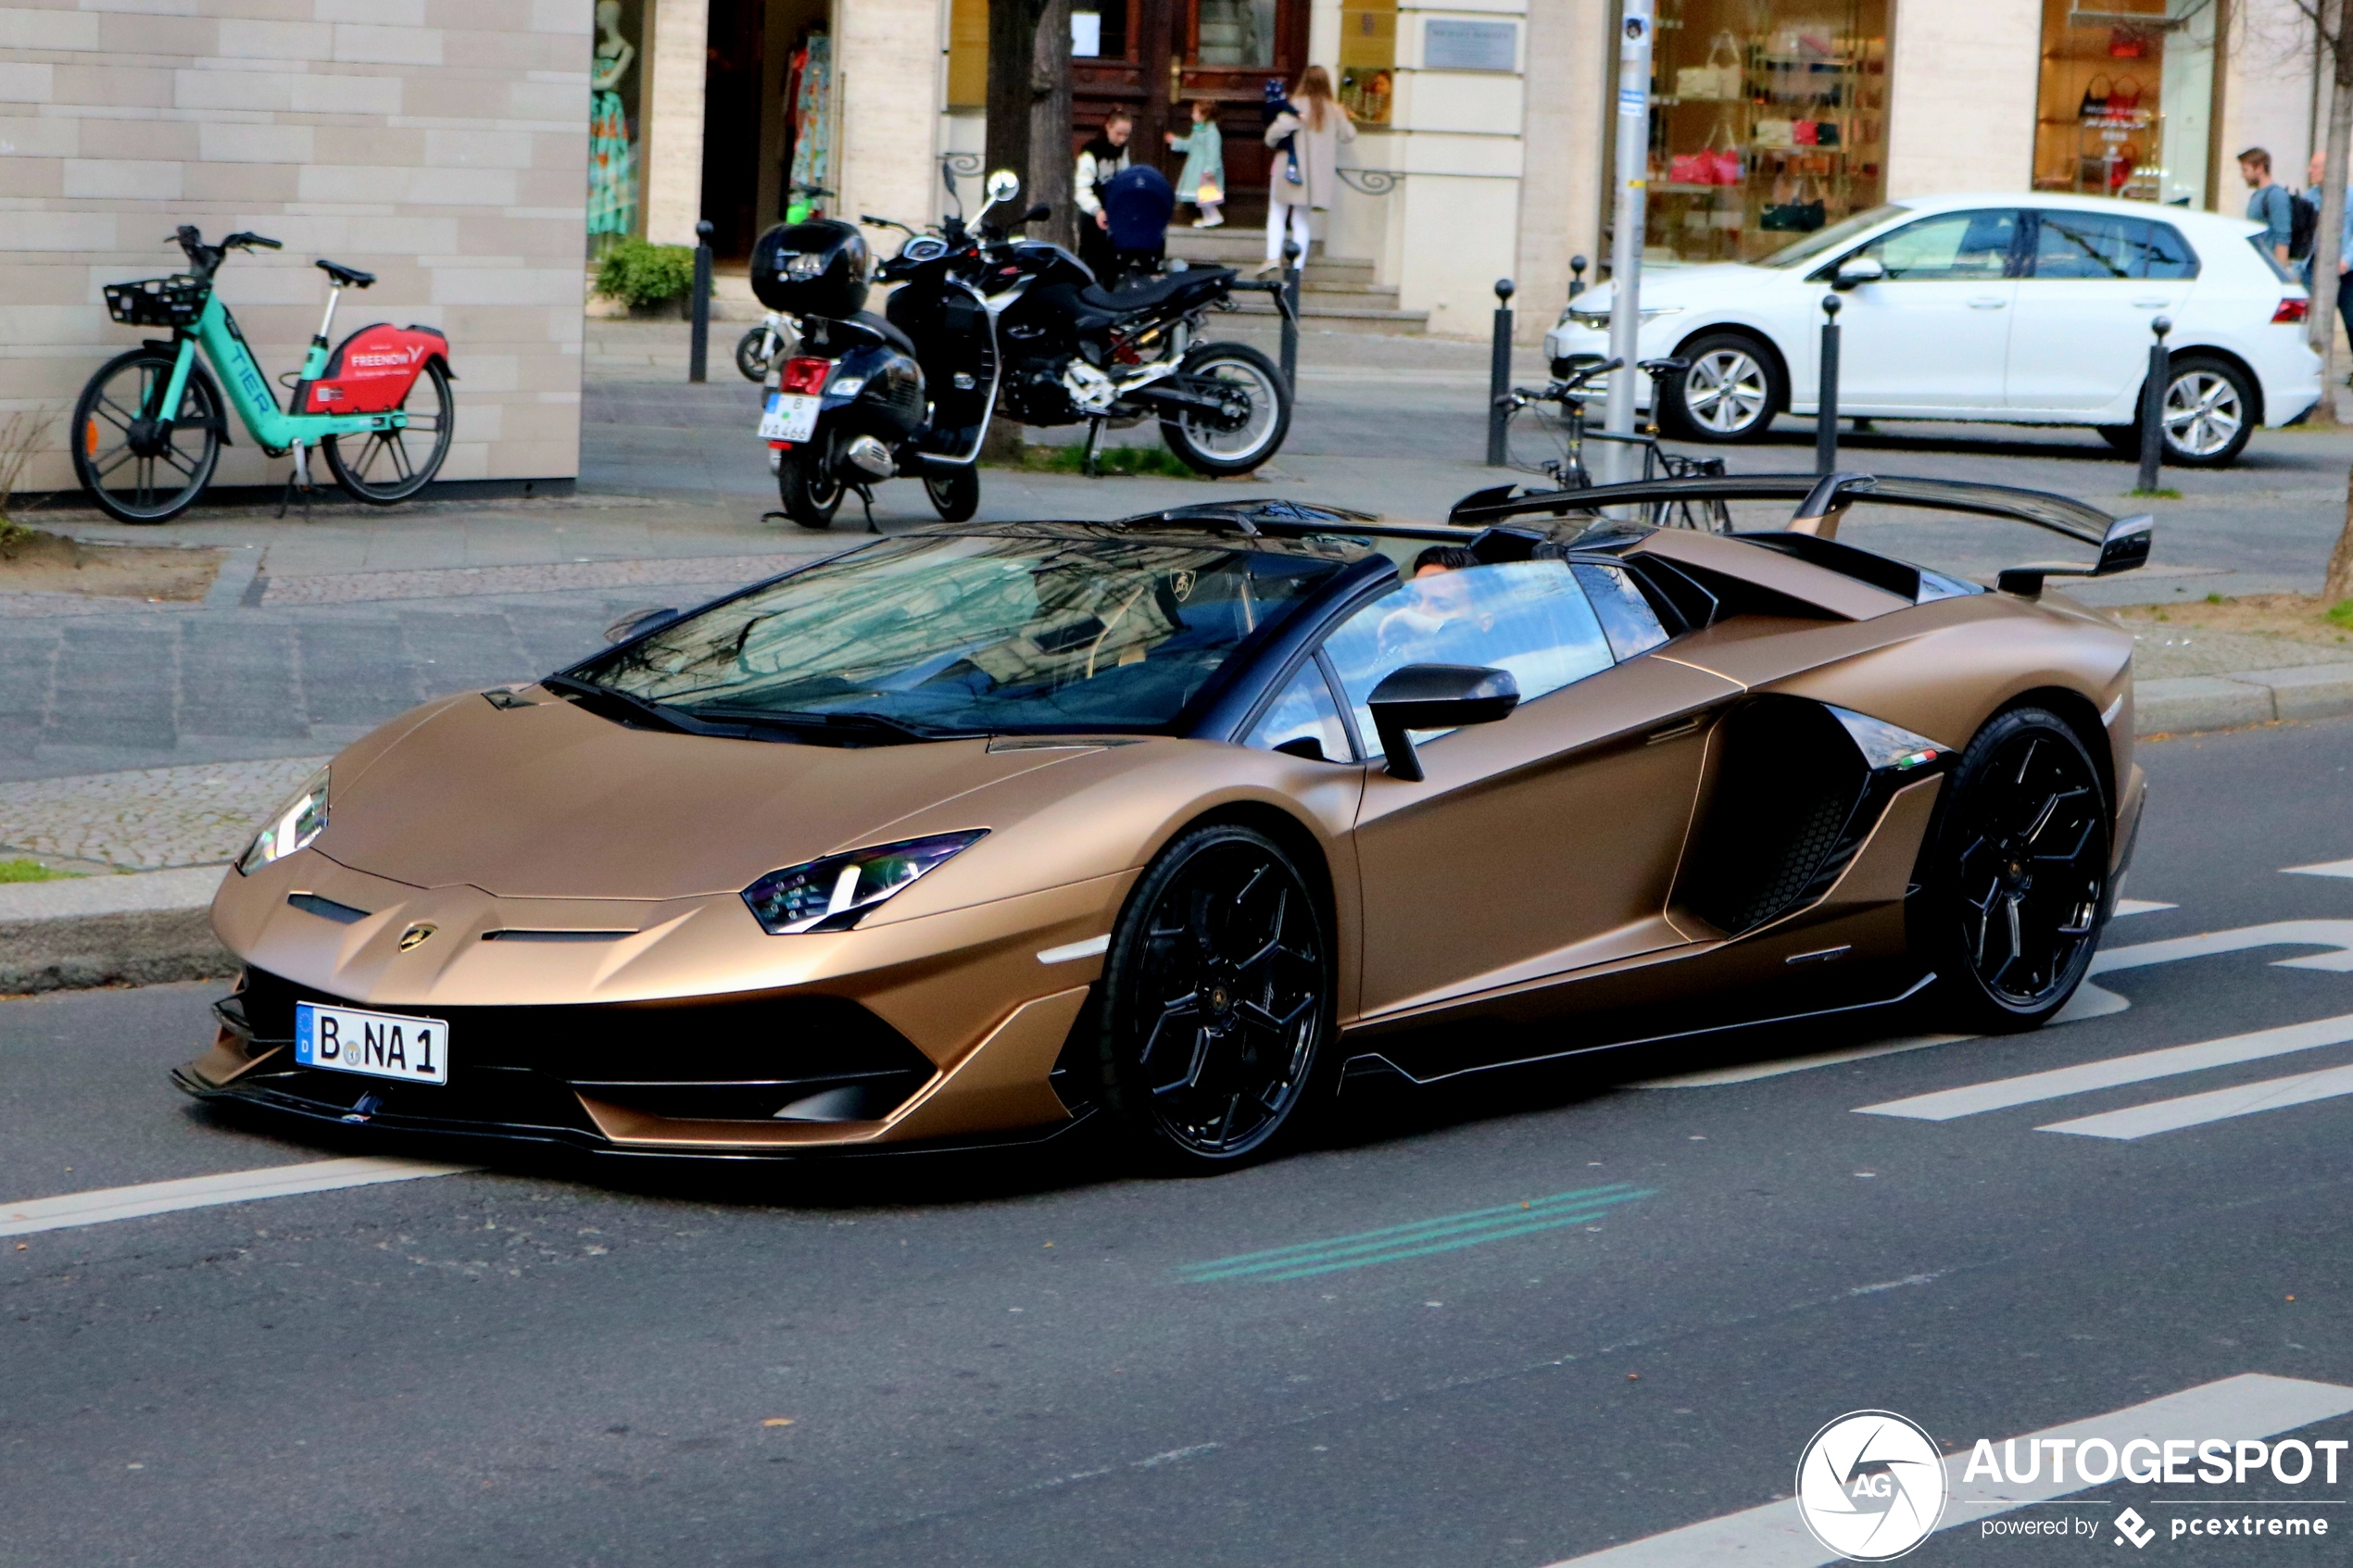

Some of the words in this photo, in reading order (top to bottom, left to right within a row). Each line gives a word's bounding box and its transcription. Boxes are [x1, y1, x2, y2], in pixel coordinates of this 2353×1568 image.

[232, 345, 271, 415] TIER
[794, 397, 803, 409] B
[301, 1040, 309, 1053] D
[321, 1016, 340, 1060] B
[365, 1022, 407, 1071] NA
[417, 1029, 435, 1074] 1
